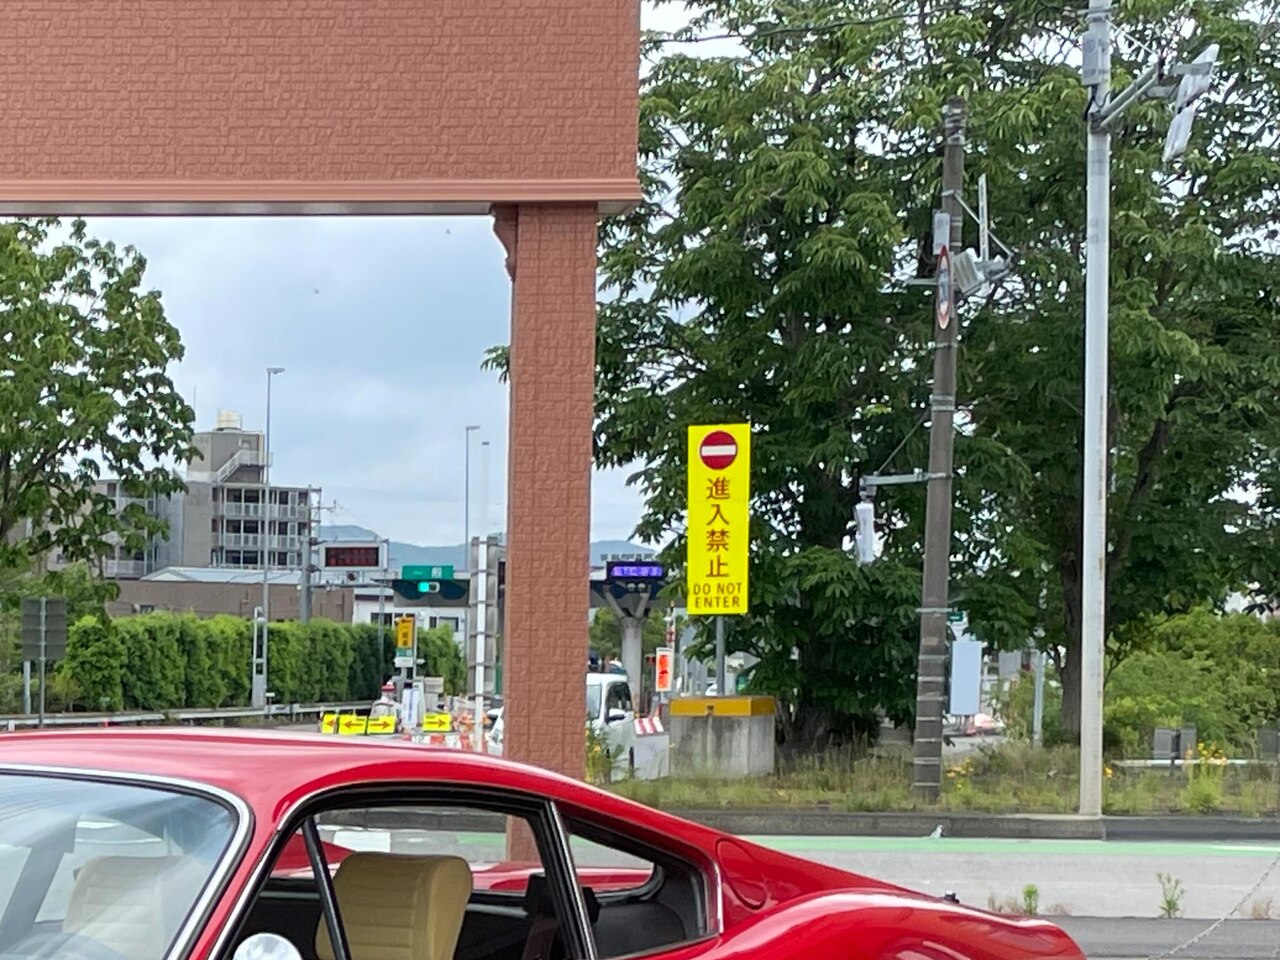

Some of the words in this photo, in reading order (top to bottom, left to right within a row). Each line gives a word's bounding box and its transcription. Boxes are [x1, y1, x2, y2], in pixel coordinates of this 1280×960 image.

[706, 476, 730, 577] 進入禁止
[693, 583, 711, 595] DO
[717, 582, 742, 595] NOT
[695, 596, 741, 608] ENTER
